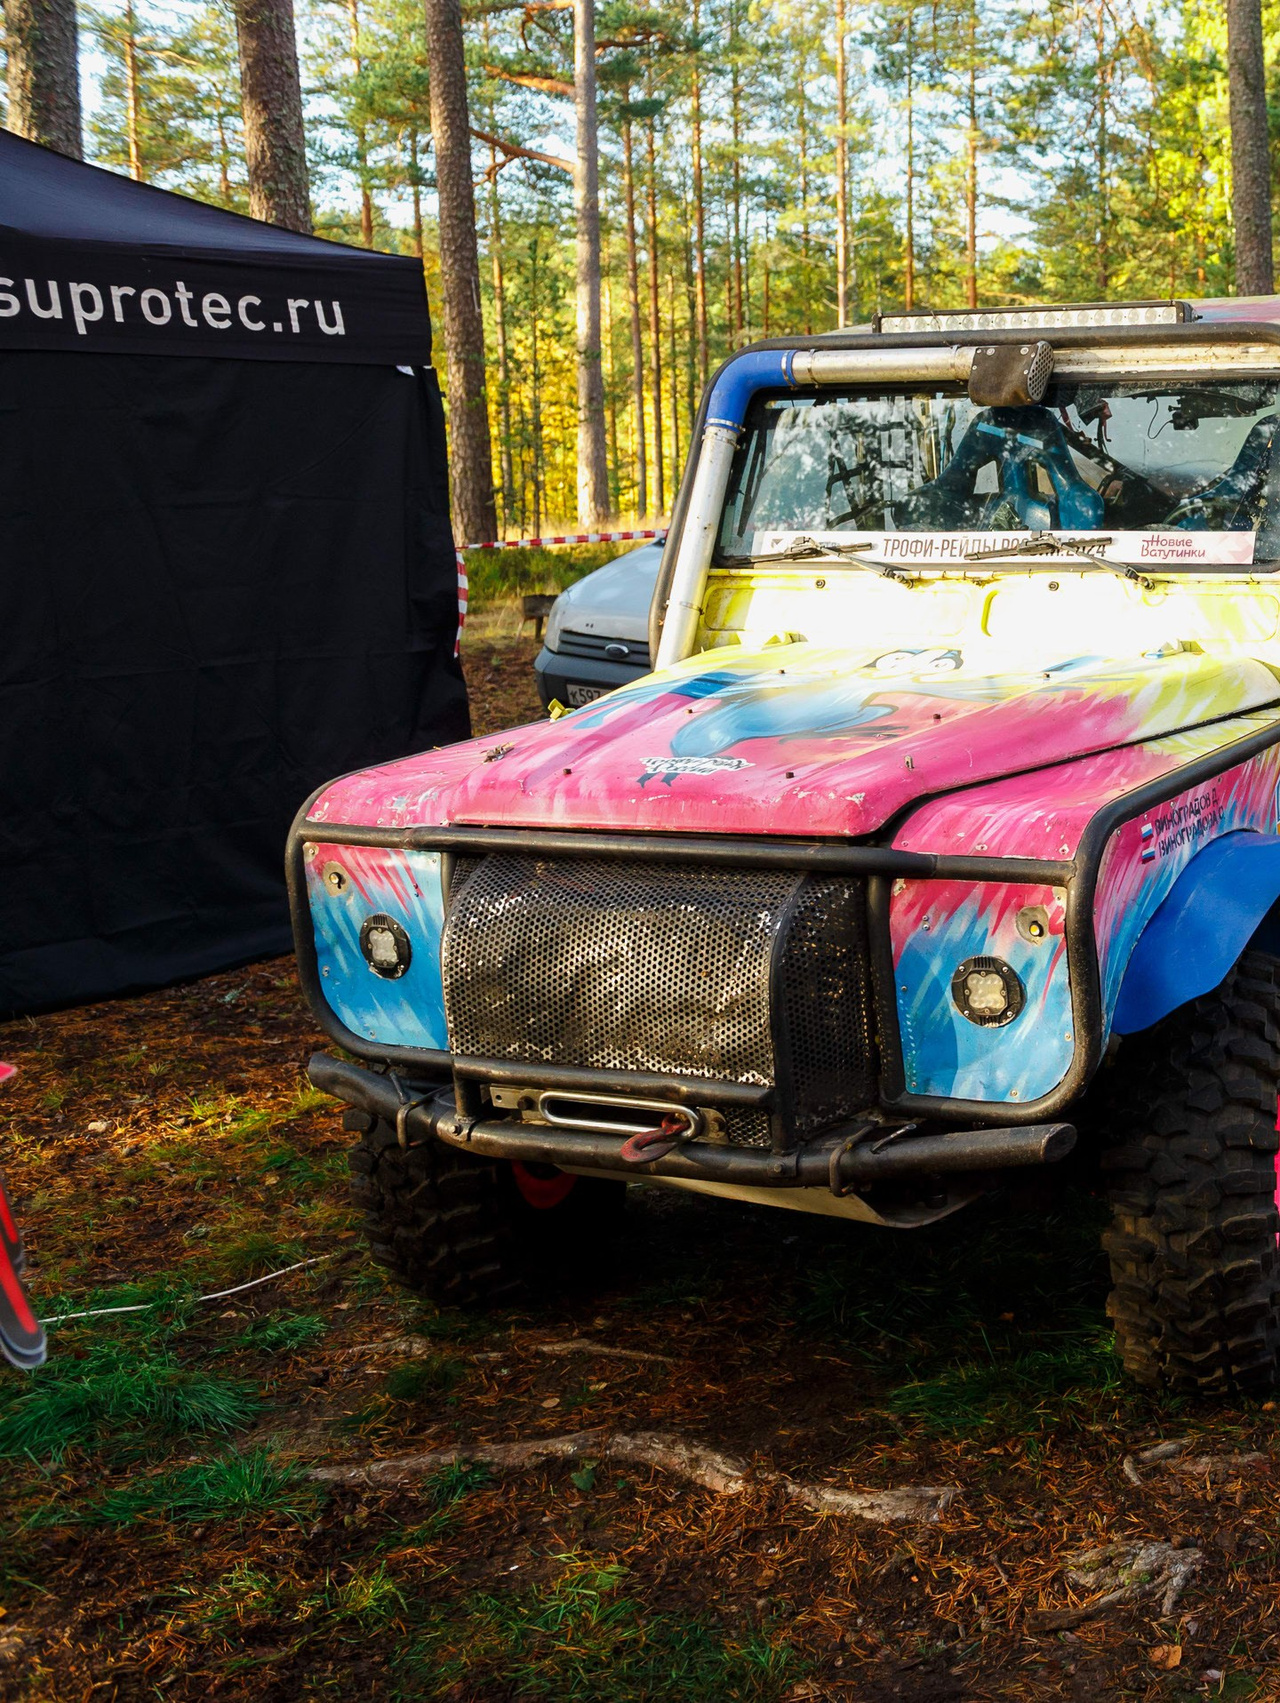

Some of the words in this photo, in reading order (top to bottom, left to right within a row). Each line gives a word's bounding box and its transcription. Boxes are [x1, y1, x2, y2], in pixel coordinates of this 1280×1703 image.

[0, 276, 346, 335] suprotec.ru
[1142, 535, 1193, 547] Новые
[1140, 542, 1206, 560] Ватутинки
